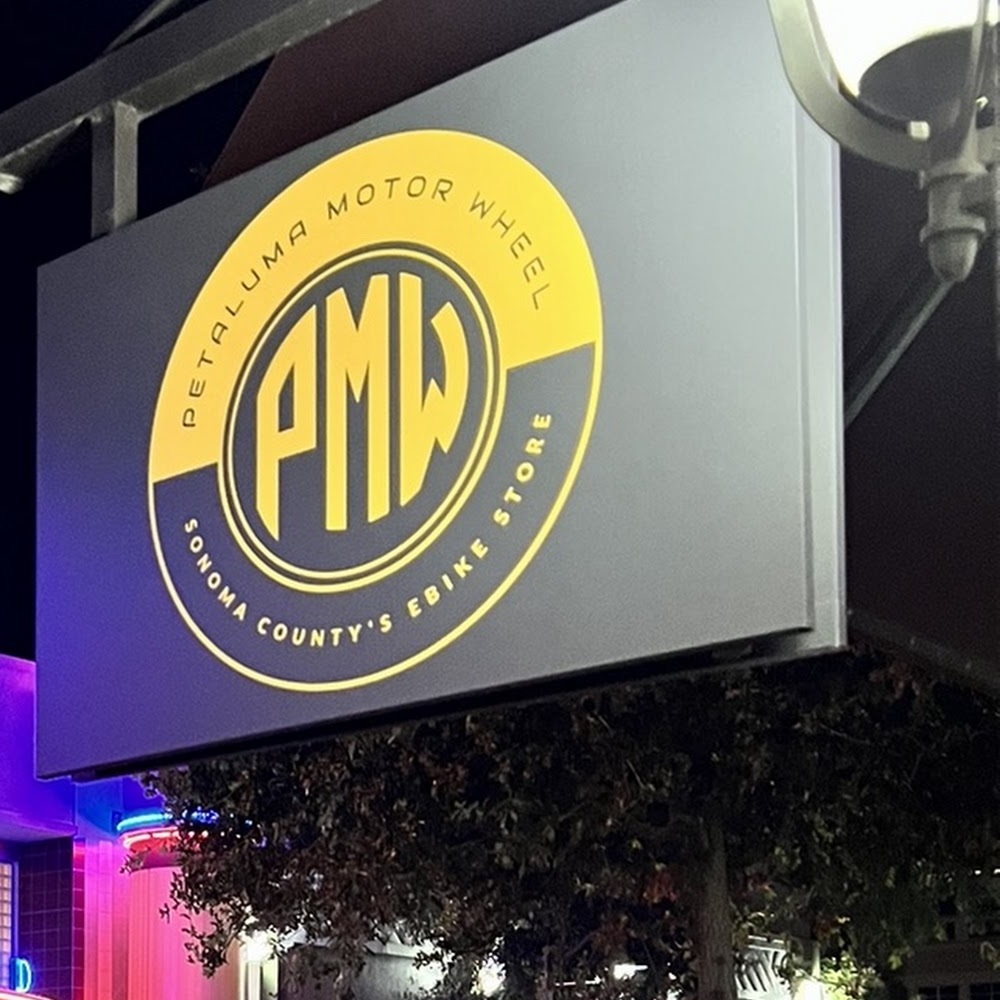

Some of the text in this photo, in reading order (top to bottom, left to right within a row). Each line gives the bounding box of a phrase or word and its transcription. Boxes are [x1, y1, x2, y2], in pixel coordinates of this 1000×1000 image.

[182, 175, 553, 428] PETALUMA MOTOR WHEEL
[256, 272, 469, 542] PMW
[184, 412, 552, 648] SONOMA COUNTY'S EBIKE STORE
